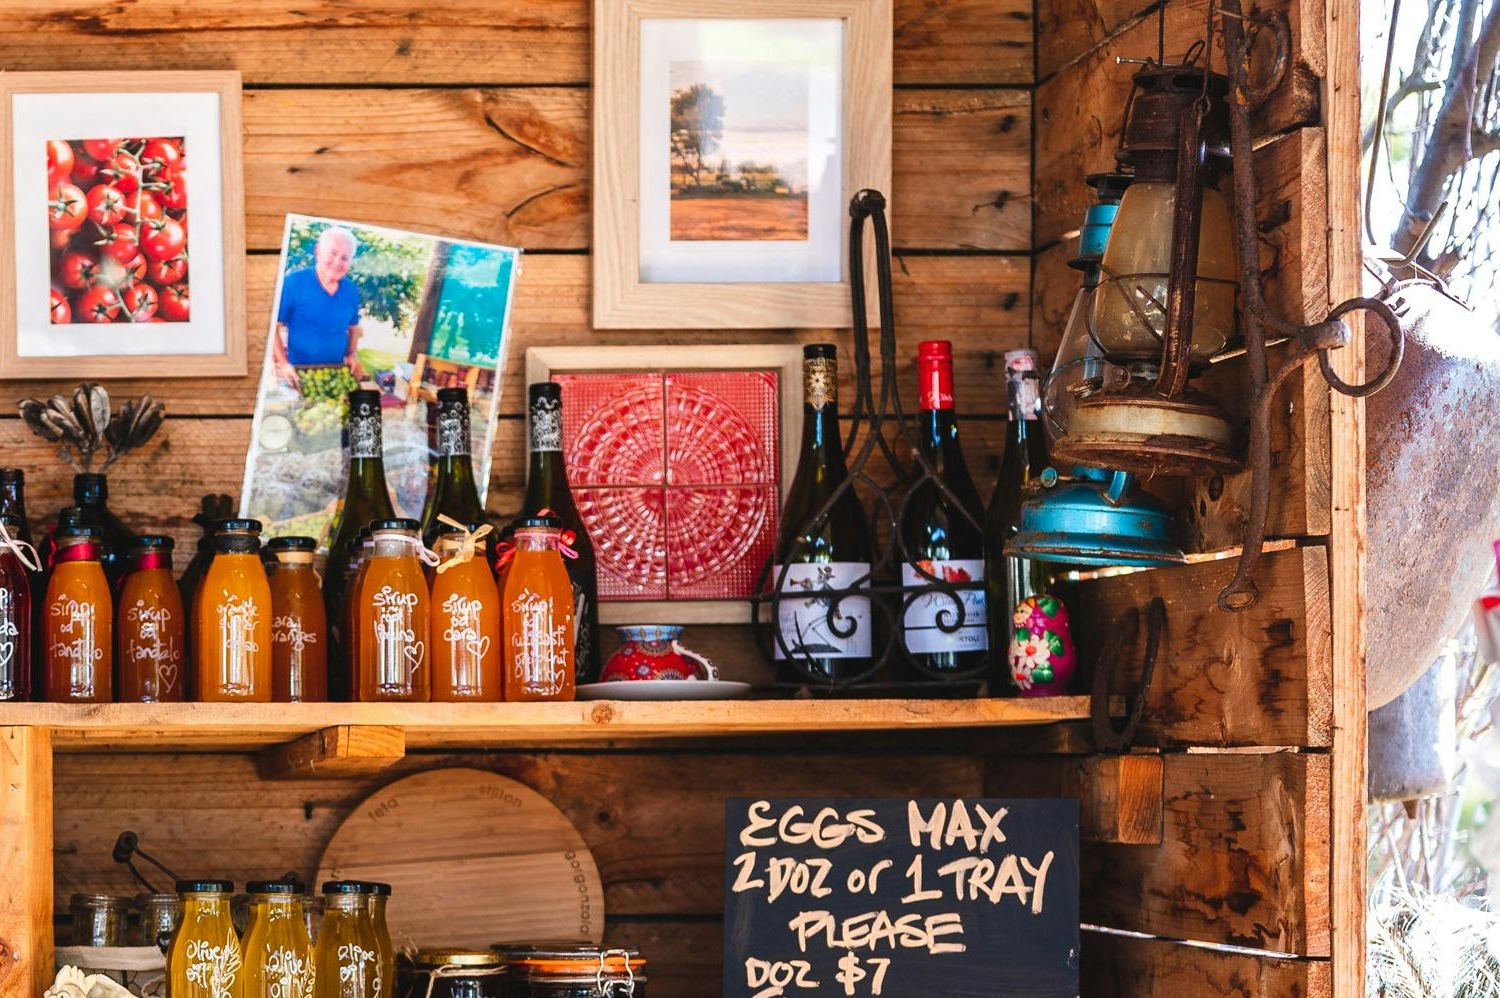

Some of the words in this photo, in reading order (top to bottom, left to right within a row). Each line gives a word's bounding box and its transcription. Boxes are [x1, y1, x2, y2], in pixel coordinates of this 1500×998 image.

[127, 600, 171, 632] sirup
[372, 585, 418, 613] sirup
[368, 796, 399, 823] feta
[739, 799, 886, 850] EGGS
[907, 799, 1010, 853] MAX
[564, 850, 591, 935] gorgonzola
[846, 858, 894, 895] or
[788, 909, 968, 954] PLEASE
[744, 956, 821, 990] DOZ
[834, 951, 892, 996] $7
